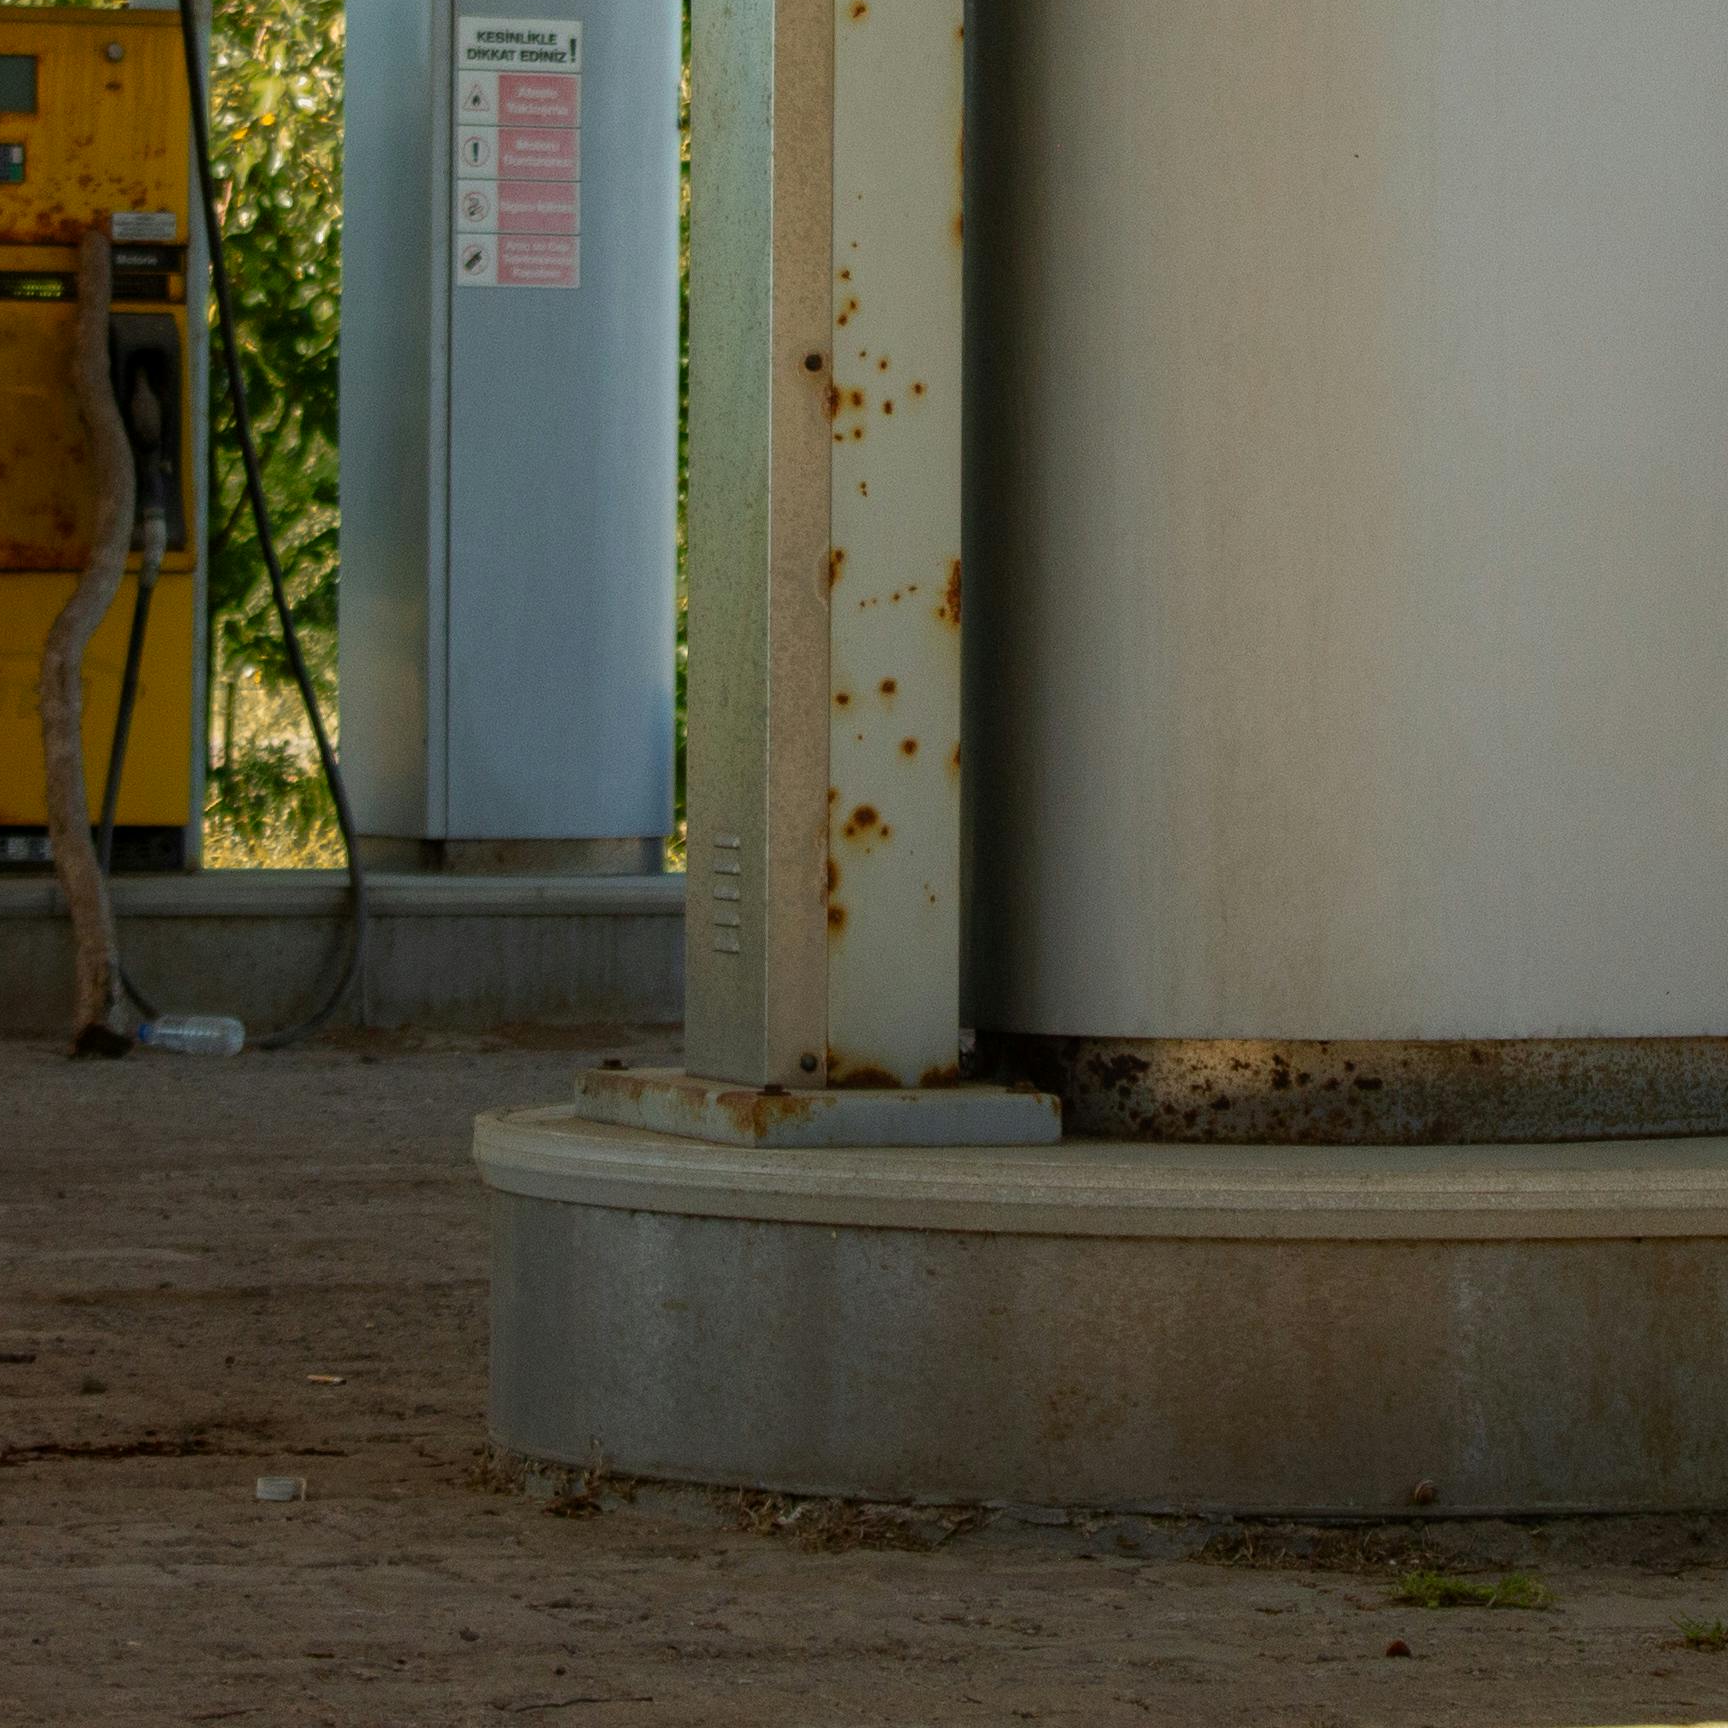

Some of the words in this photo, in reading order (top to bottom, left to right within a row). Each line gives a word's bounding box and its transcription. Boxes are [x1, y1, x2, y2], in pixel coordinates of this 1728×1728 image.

[477, 29, 558, 46] KESİNLİKLE
[466, 46, 517, 61] DİKKAT
[521, 48, 567, 63] EDİNİZ
